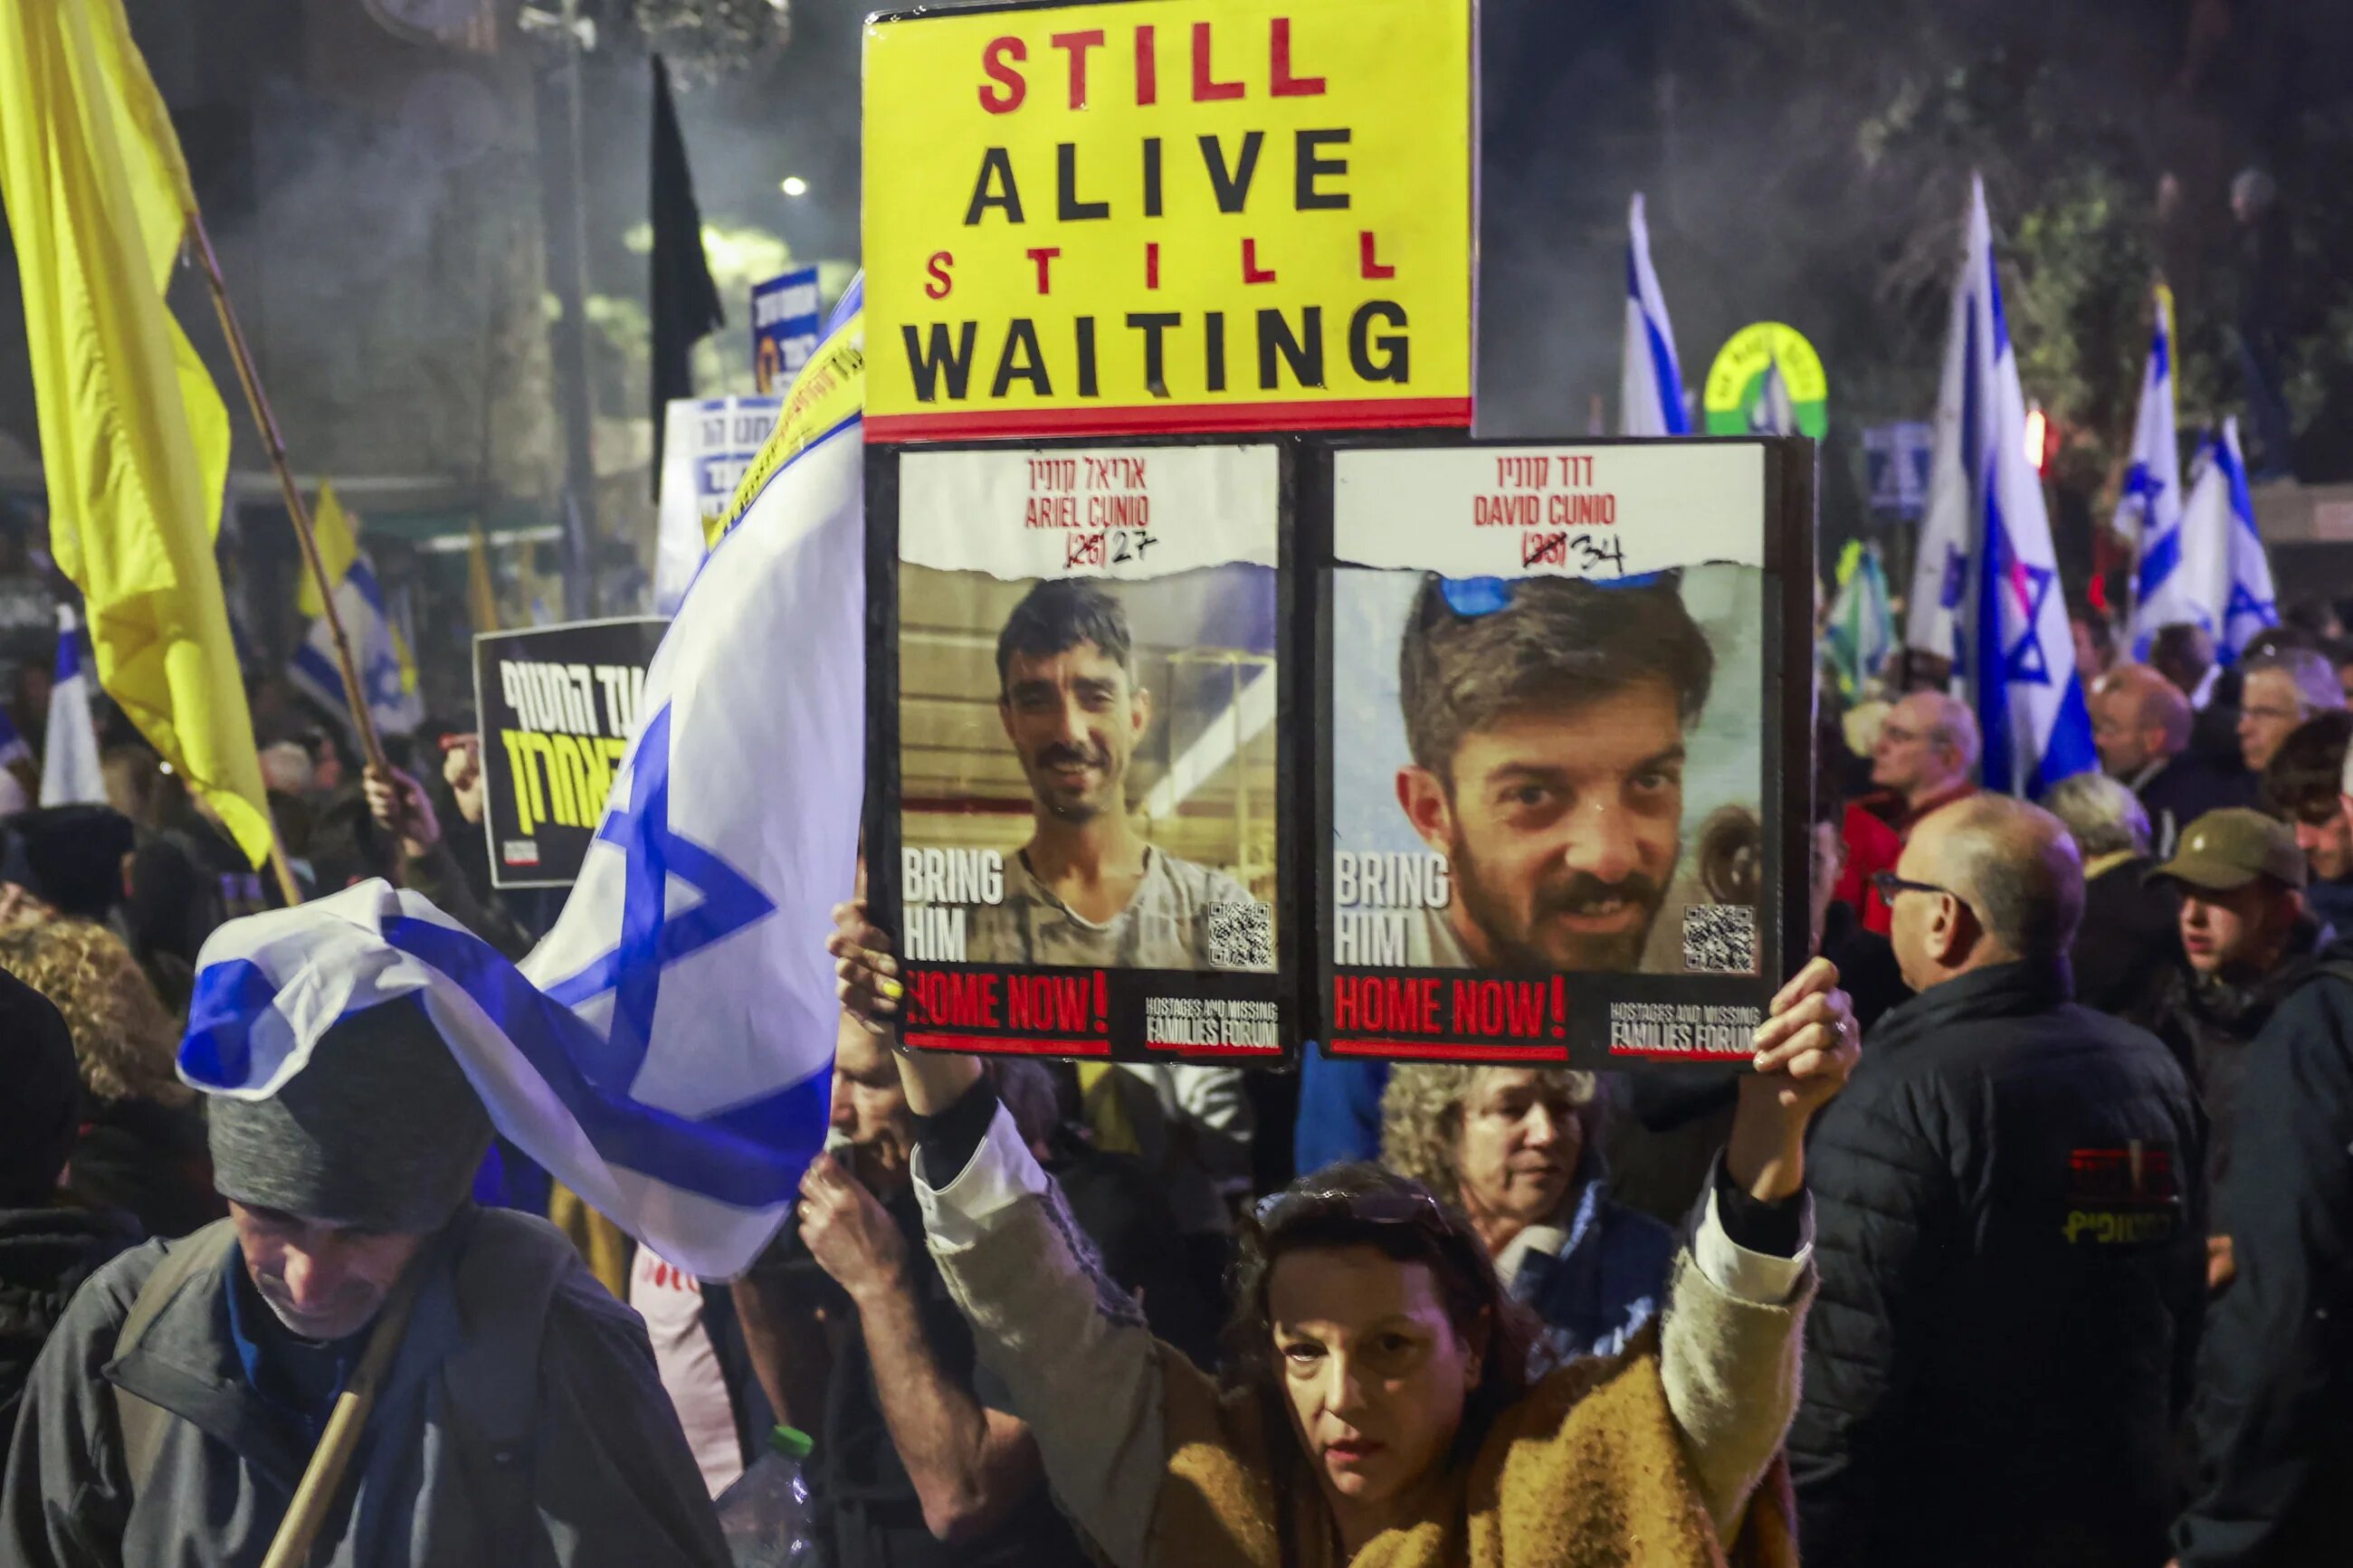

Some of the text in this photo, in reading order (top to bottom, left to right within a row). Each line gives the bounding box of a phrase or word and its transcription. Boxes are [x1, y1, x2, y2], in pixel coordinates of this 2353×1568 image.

[977, 18, 1326, 115] STILL
[964, 128, 1351, 226] ALIVE
[925, 231, 1395, 299] STILL
[901, 300, 1409, 404] WAITING
[1029, 456, 1146, 493] אריאל קוניו
[1496, 455, 1594, 490] דוד קוניו
[1025, 496, 1149, 527] ARIEL CUNIO
[1474, 493, 1616, 527] DAVID CUNIO
[1112, 529, 1158, 564] 27
[1570, 534, 1627, 575] 34
[500, 660, 600, 736] החטוף
[902, 847, 1005, 905] BRING
[1334, 851, 1450, 908] BRING
[903, 907, 967, 963] HIM
[1333, 908, 1408, 966] HIM
[1007, 969, 1110, 1034] NOW!
[1146, 997, 1279, 1022] HOSTAGES AND MISSING
[1334, 974, 1566, 1040] HOME NOW!
[1611, 1002, 1761, 1027] HOSTAGES AND MISSING
[1146, 1015, 1280, 1049] FAMILIES FORUM
[1611, 1021, 1692, 1052] FAMILIES
